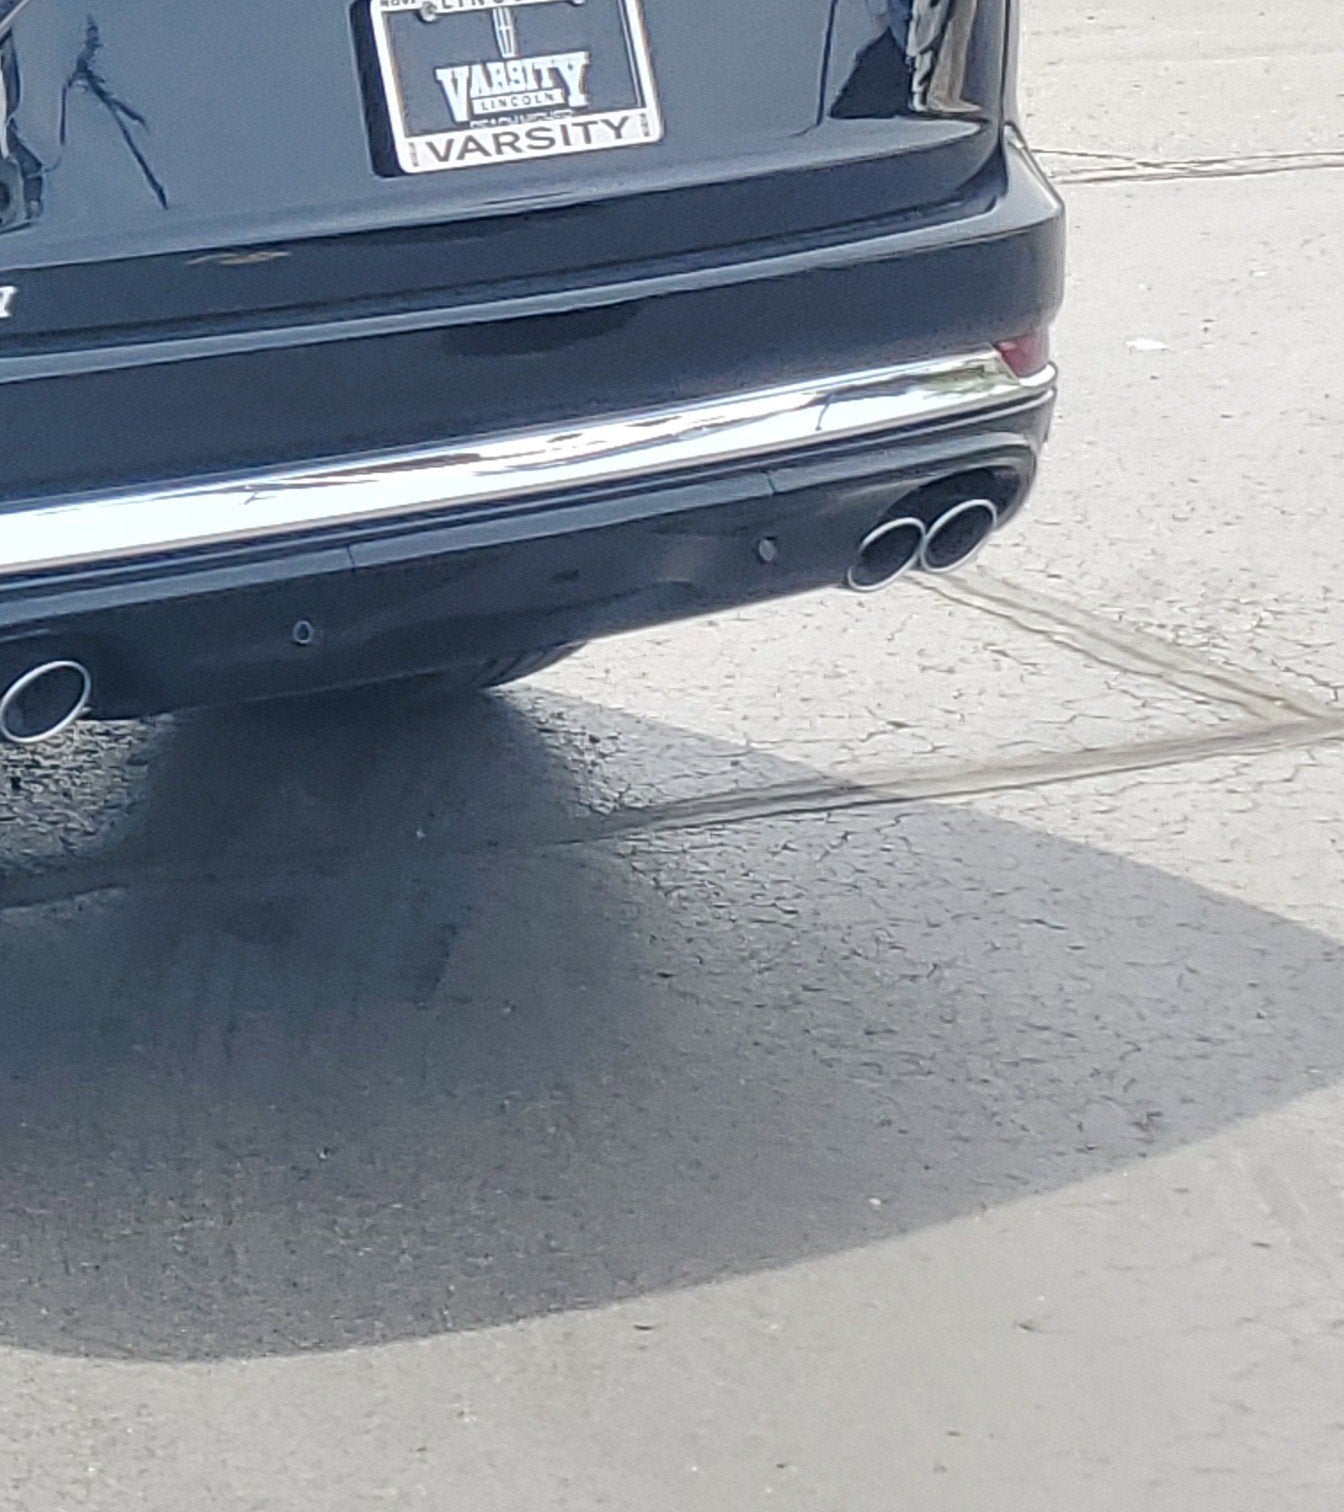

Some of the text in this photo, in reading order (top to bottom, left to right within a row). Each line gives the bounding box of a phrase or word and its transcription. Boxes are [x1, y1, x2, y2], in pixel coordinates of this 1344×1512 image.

[435, 51, 590, 123] VARSITY
[481, 92, 555, 111] LINCOLN
[426, 115, 630, 163] VARSITY
